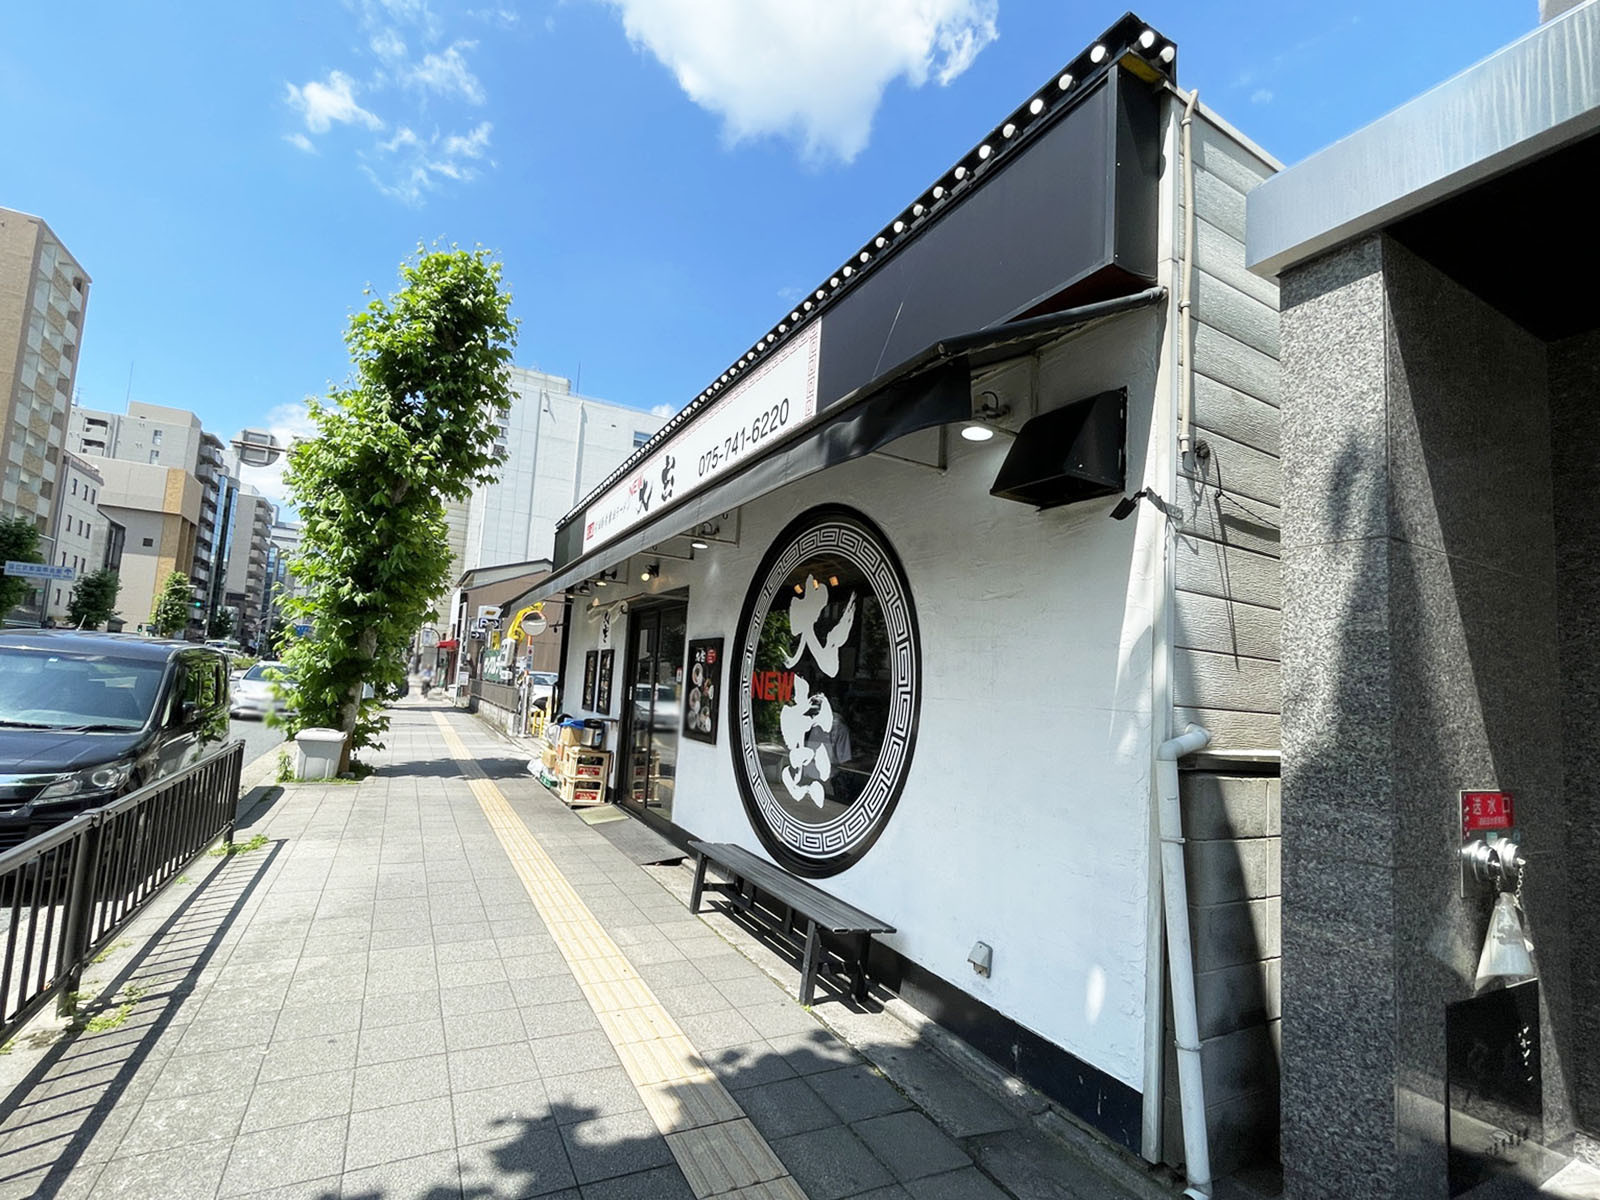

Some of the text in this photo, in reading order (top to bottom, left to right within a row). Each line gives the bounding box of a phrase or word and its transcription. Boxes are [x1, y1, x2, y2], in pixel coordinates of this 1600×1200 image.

[697, 397, 790, 478] 075-741-6220
[750, 671, 795, 702] NEW
[1472, 796, 1511, 816] 送水口
